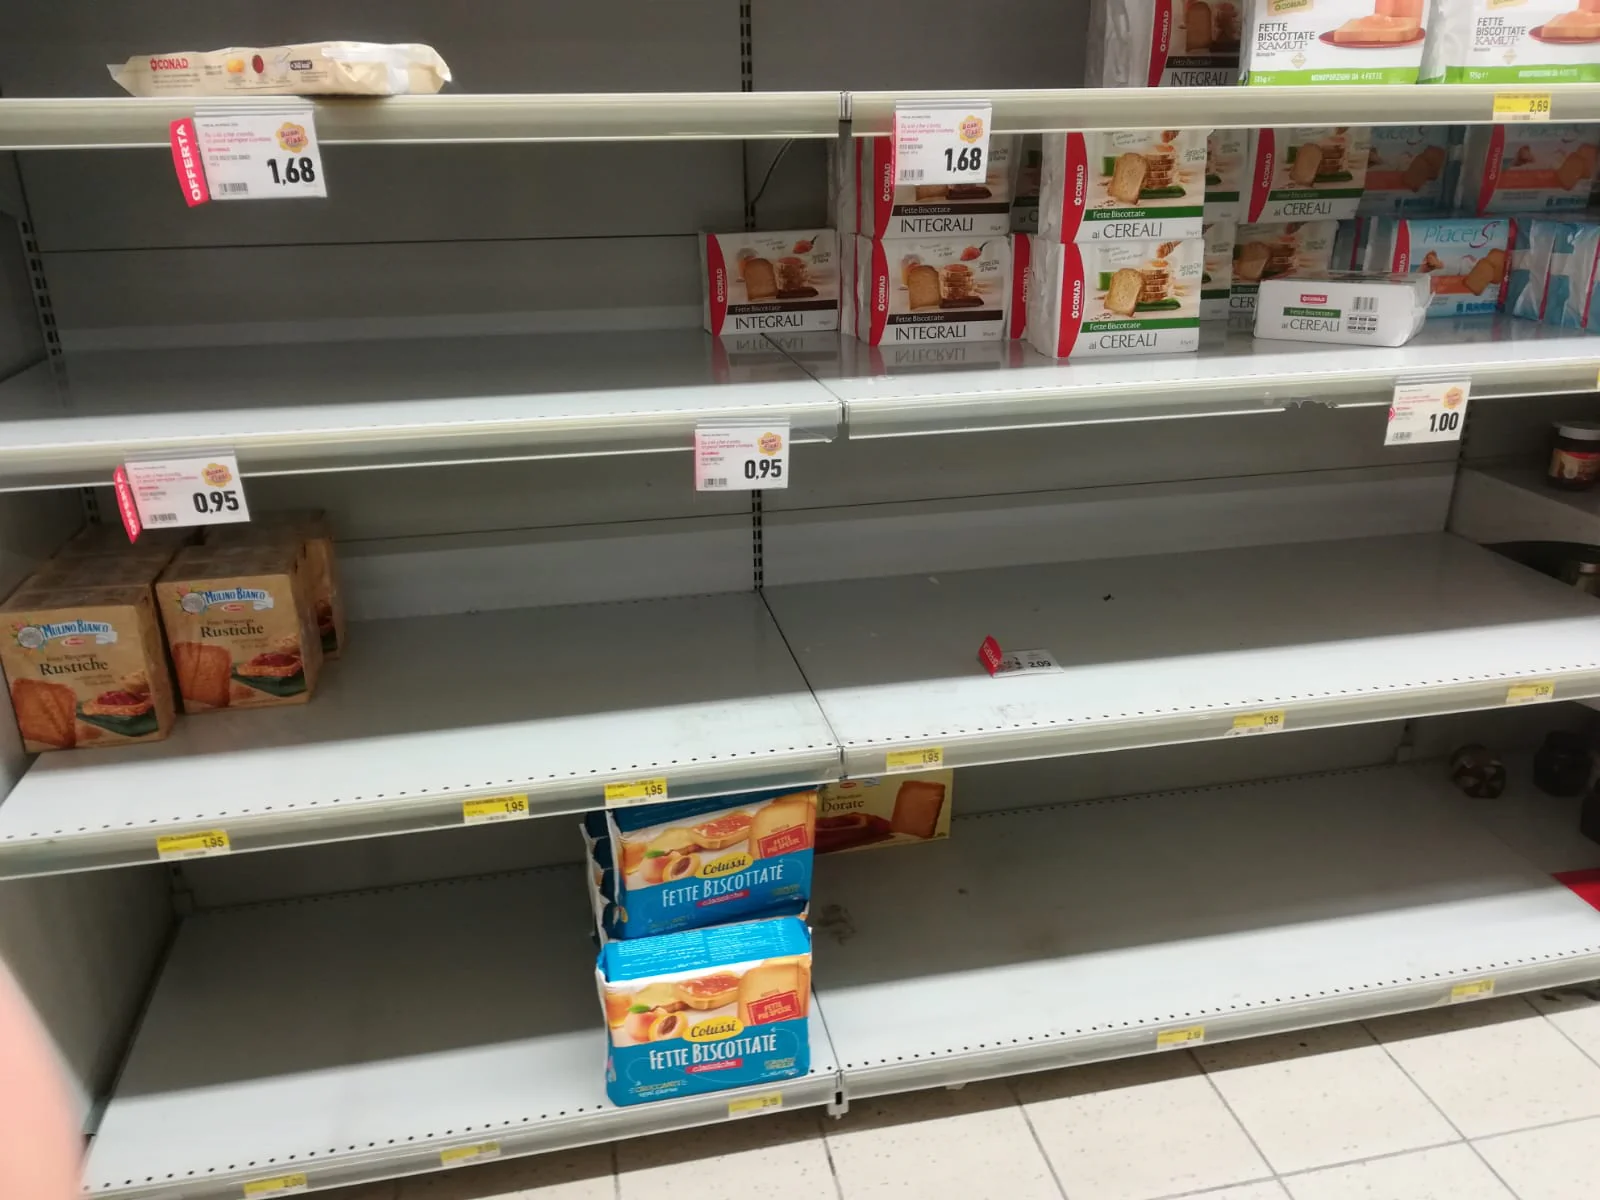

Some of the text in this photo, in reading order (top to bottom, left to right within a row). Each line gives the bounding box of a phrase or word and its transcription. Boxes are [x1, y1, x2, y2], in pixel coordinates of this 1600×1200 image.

[1161, 10, 1169, 44] CONAD
[1259, 22, 1288, 32] FETTE
[1477, 17, 1504, 26] FETTE
[1258, 31, 1315, 41] BISCOTTATE
[1476, 26, 1526, 36] BISCOTTATE
[158, 57, 189, 71] CONAD
[1170, 71, 1229, 86] INTEGRALI
[1529, 100, 1548, 114] 2,69
[176, 124, 201, 201] OFFERTA
[944, 147, 982, 173] 1,68
[267, 157, 316, 187] 1,68
[1075, 164, 1085, 196] CONAD
[901, 206, 951, 214] Fette Biscottate
[1093, 210, 1146, 219] Fette Biscottate
[1283, 201, 1333, 216] CEREALI
[900, 217, 974, 233] INTEGRALI
[1092, 222, 1163, 239] ai CEREALI
[1073, 280, 1081, 311] CONAD
[735, 313, 803, 330] INTEGRALI
[896, 314, 945, 323] Fette Biscottate
[1089, 322, 1141, 331] Fette Biscottate
[1290, 318, 1340, 332] CEREALI
[895, 325, 966, 341] INTEGRALI
[1089, 333, 1158, 349] ai CEREALI
[745, 459, 782, 480] 0,95
[193, 490, 240, 514] 0,95
[204, 587, 266, 604] MULINO BIANCO
[40, 618, 109, 639] MULINO BIANCO
[200, 623, 264, 638] Rustiche
[39, 657, 109, 676] Rustiche
[1264, 715, 1279, 727] 1,39
[922, 752, 940, 764] 1,95
[644, 784, 664, 798] 1,95
[504, 800, 524, 814] 1,95
[821, 796, 865, 812] Dorate
[202, 837, 225, 850] 1,95
[703, 856, 747, 875] Colussi
[662, 864, 784, 908] FETTE BISCOTTATE
[691, 1020, 737, 1038] Colussi
[649, 1034, 777, 1071] FETTE BISCOTTATE
